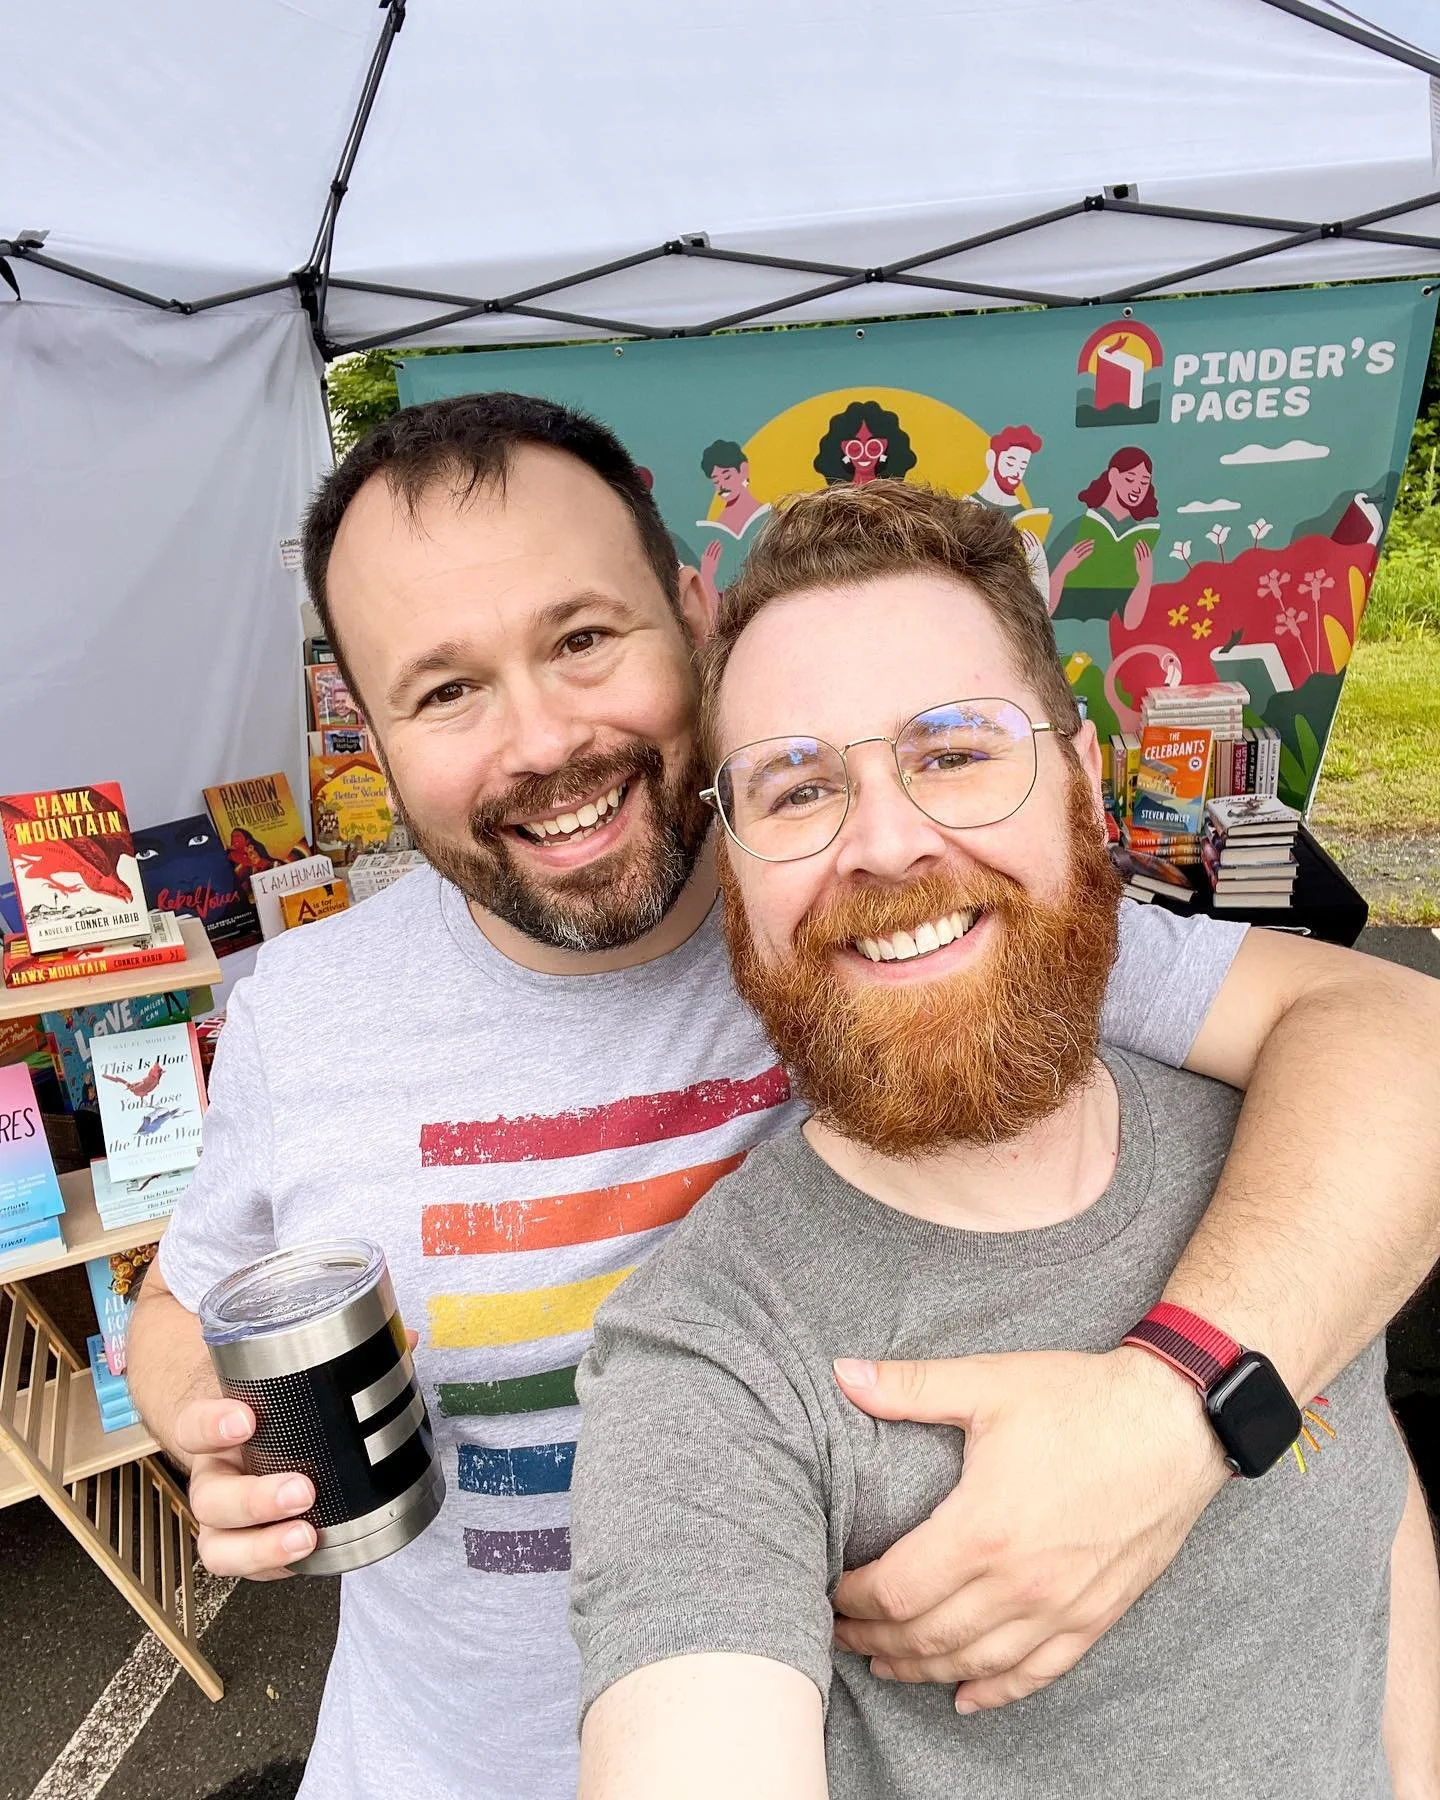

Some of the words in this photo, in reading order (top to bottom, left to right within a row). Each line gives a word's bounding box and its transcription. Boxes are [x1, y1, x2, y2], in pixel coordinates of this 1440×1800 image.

[1172, 336, 1397, 388] PINDER'S
[1170, 385, 1312, 424] PAGES
[1168, 731, 1181, 742] THE
[1144, 739, 1206, 761] CELEBRANTS
[33, 790, 95, 818] HAWK
[219, 776, 279, 812] RAINBOW
[333, 790, 359, 800] Better
[360, 787, 387, 798] World
[227, 799, 285, 828] REVOLUTIONS
[1141, 809, 1165, 822] STEVEN
[1166, 812, 1190, 823] ROWLEY
[14, 811, 121, 845] MOUNTAIN
[258, 879, 268, 894] I
[271, 873, 289, 891] AM
[291, 862, 331, 887] HUMAN
[157, 884, 203, 912] Rebel
[196, 877, 241, 920] Voices
[298, 898, 317, 922] A
[38, 929, 43, 937] A
[44, 926, 64, 937] NOVEL
[75, 916, 110, 932] CONNER
[112, 912, 140, 926] HABIB
[11, 969, 45, 985] HAWK
[47, 959, 108, 979] MOUNTAIN
[113, 955, 140, 969] CONNER
[141, 952, 163, 963] HABIB
[101, 1061, 133, 1075] This
[138, 1058, 151, 1070] Is
[156, 1053, 188, 1066] How
[121, 1097, 144, 1111] You
[146, 1094, 182, 1108] Lose
[109, 1140, 130, 1153] the
[134, 1134, 170, 1148] Time
